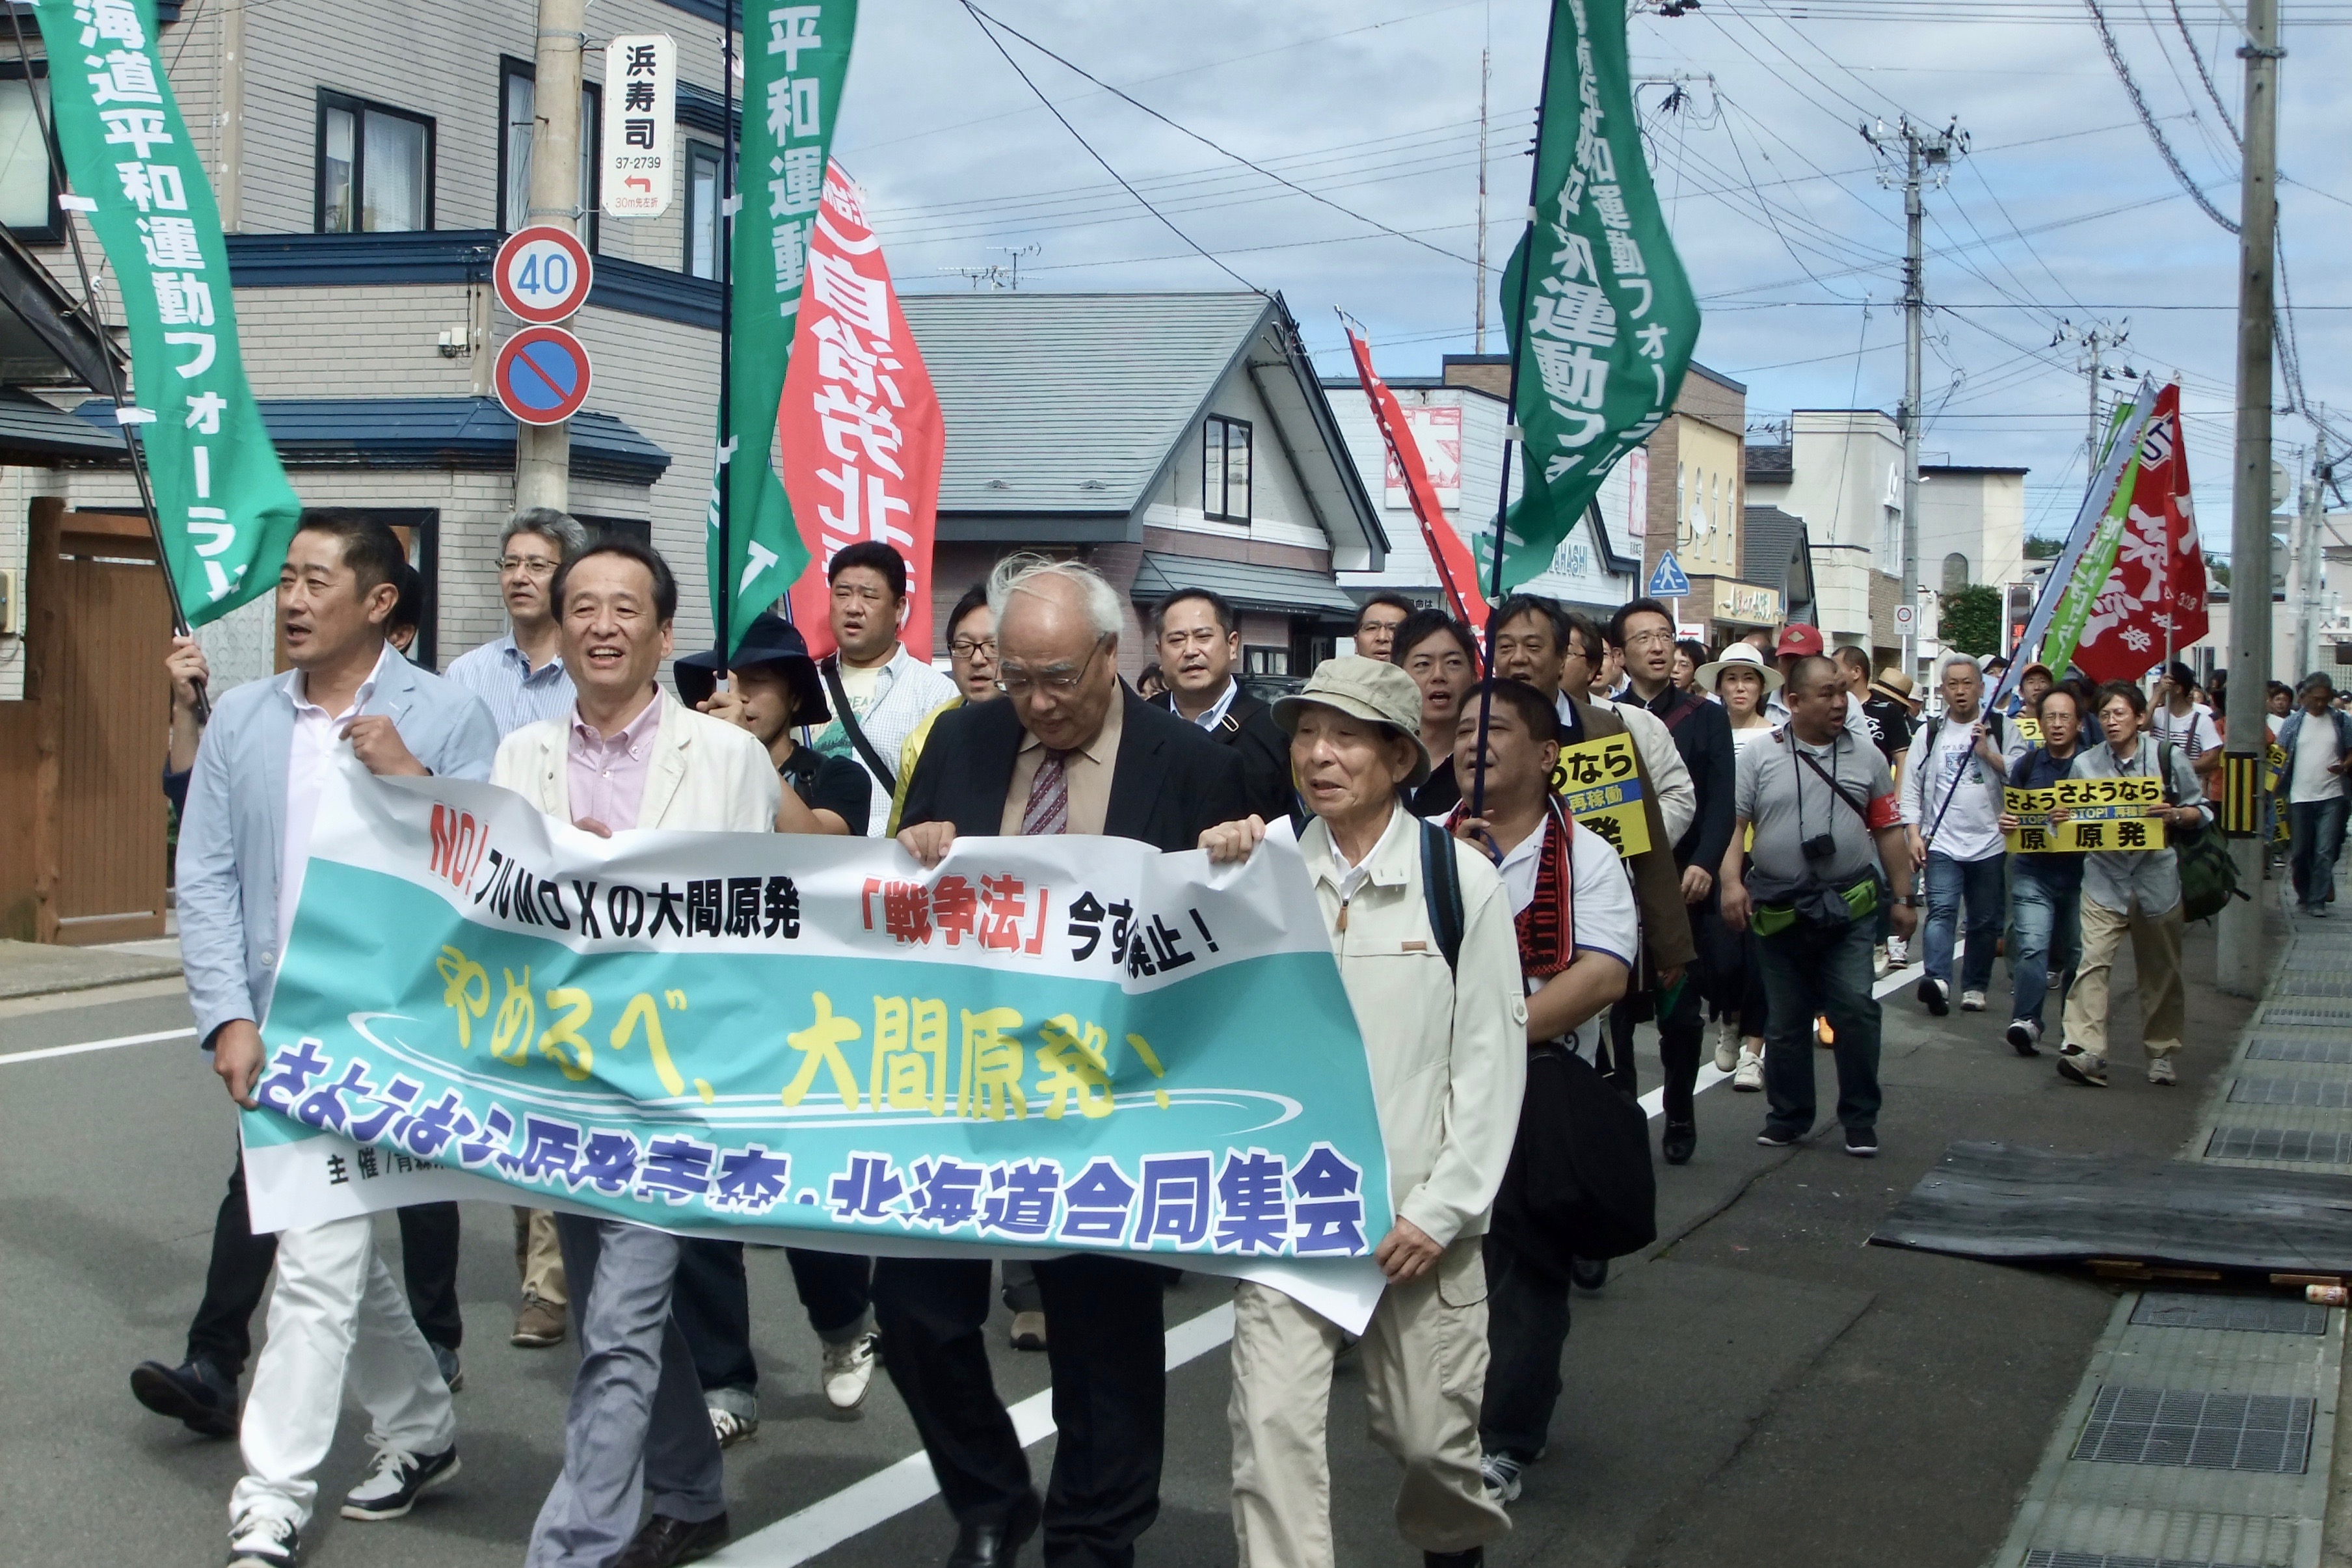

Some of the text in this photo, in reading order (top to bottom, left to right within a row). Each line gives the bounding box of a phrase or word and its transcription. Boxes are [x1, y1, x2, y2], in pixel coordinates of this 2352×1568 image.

[625, 44, 656, 150] 浜寿司
[615, 157, 661, 169] 37-2739
[517, 254, 568, 295] 40
[2058, 781, 2159, 804] さようなら
[2020, 828, 2046, 850] 原
[2076, 822, 2146, 848] 原発
